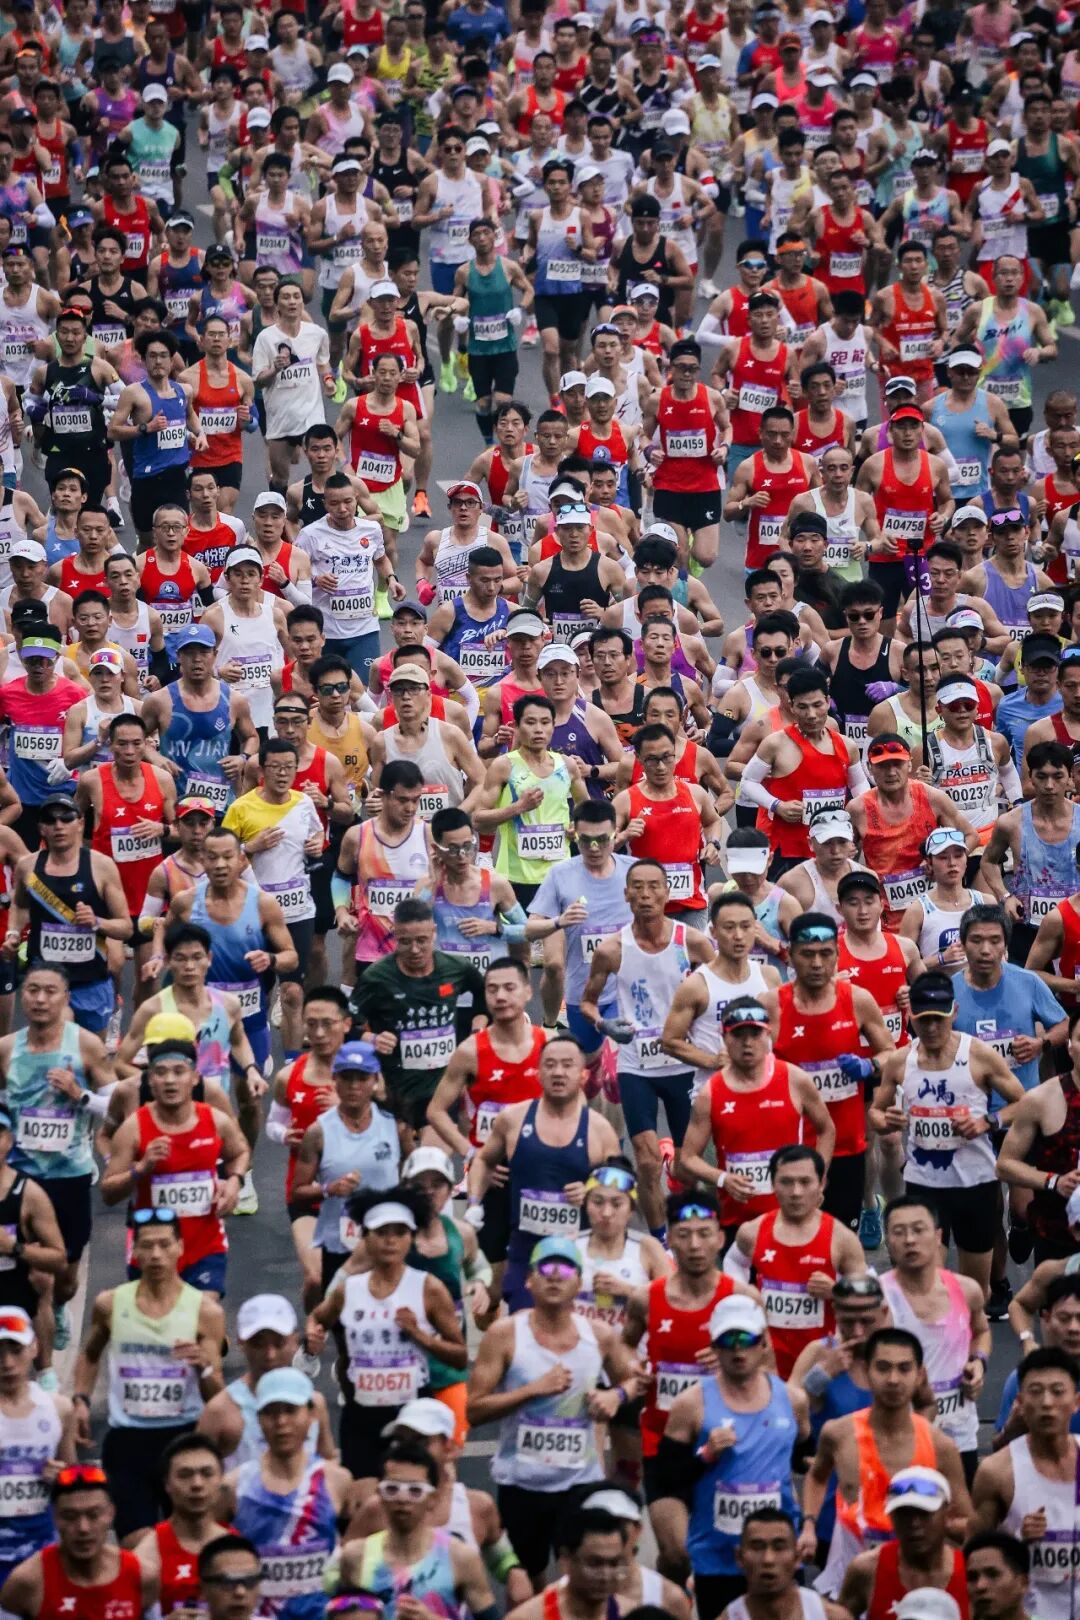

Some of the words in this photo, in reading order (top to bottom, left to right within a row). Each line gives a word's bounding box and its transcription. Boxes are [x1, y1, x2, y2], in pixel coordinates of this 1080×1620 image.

[280, 367, 311, 380] A04771
[55, 414, 88, 426] A03018
[200, 416, 235, 427] A04427
[670, 438, 704, 450] A04159
[361, 461, 393, 475] A04173
[961, 466, 980, 478] 623
[885, 518, 924, 532] A04758
[332, 596, 371, 611] A04080
[462, 654, 504, 667] A06544
[16, 736, 59, 750] A05697
[345, 755, 358, 766] 80
[946, 764, 988, 779] PACER
[522, 836, 562, 851] A05537
[890, 880, 934, 901] A04192
[42, 936, 93, 952] A03280
[886, 1017, 900, 1032] 95
[404, 1038, 453, 1058] A04790
[23, 1122, 70, 1140] A03713
[522, 1202, 578, 1224] A03969
[766, 1294, 819, 1316] A05791
[357, 1372, 411, 1392] A20671
[124, 1382, 184, 1403] A03249
[522, 1431, 582, 1453] A05815
[260, 1558, 325, 1582] A03222
